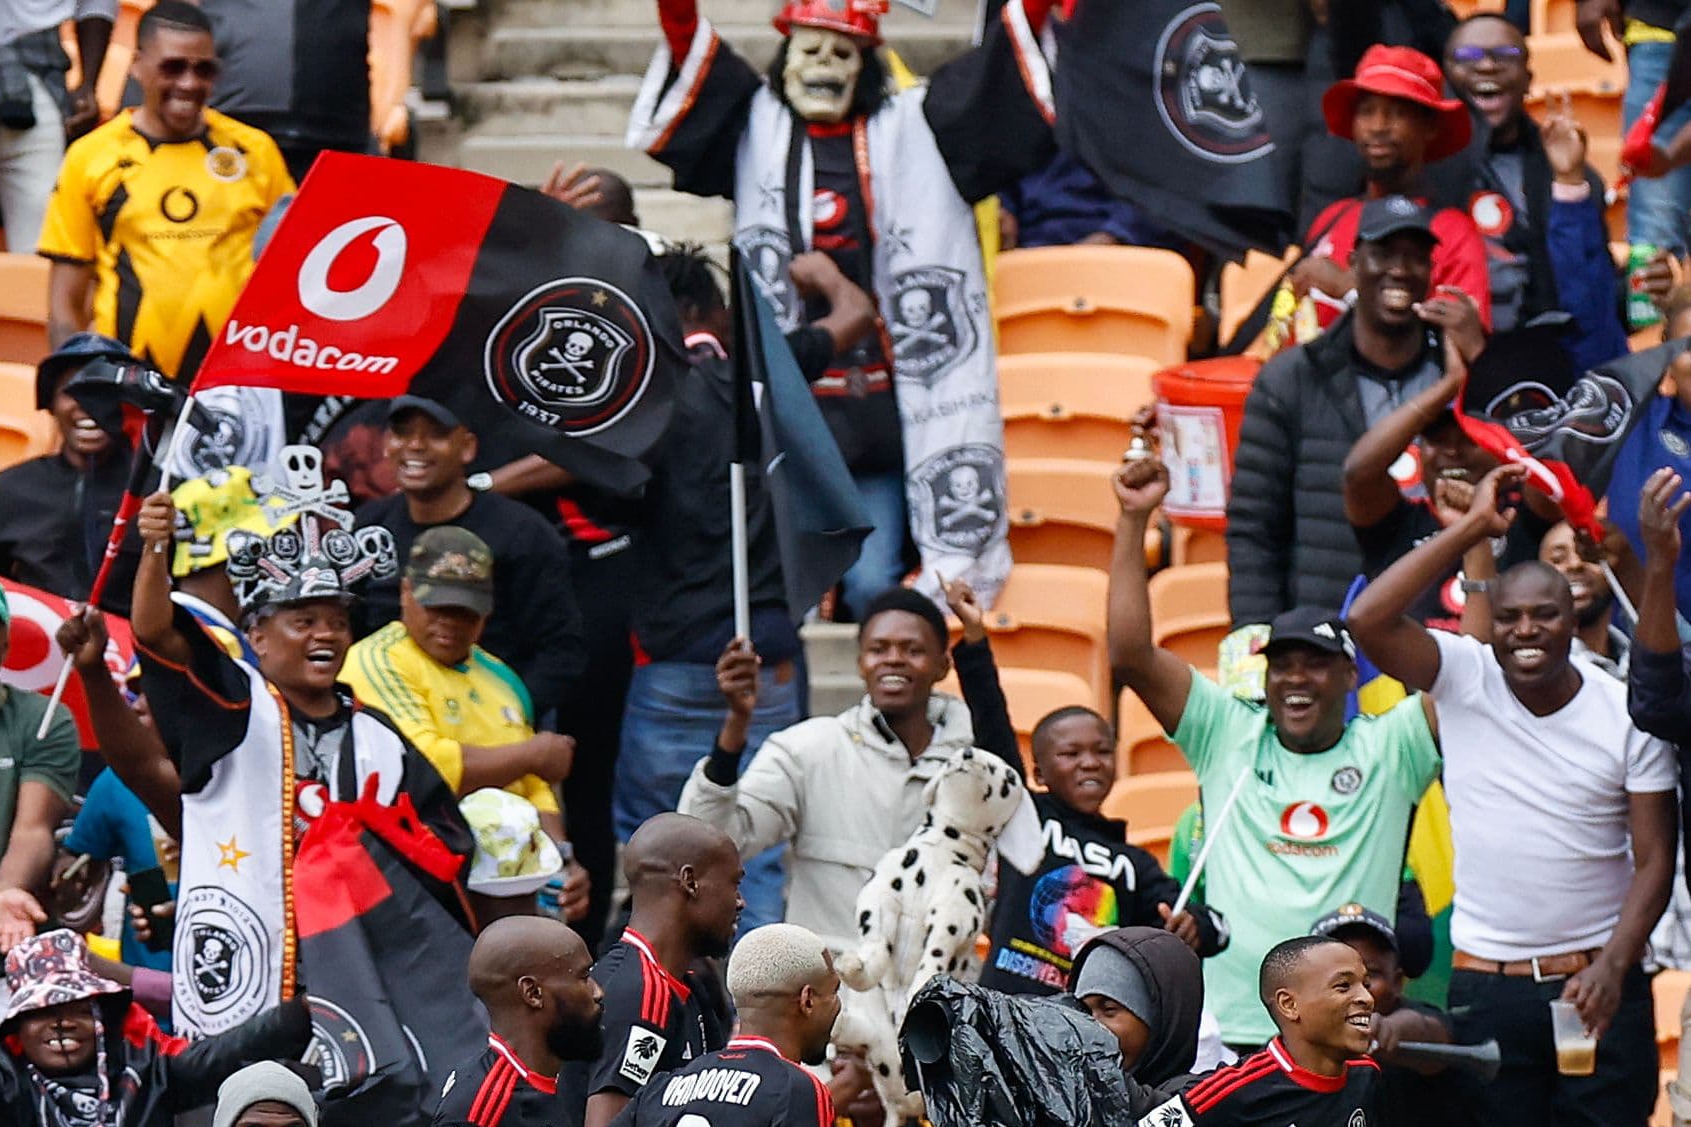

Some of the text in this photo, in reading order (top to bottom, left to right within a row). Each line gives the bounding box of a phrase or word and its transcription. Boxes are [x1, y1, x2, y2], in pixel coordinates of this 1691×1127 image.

[225, 319, 400, 375] vodacom
[552, 319, 616, 349] ORLANDO
[530, 369, 586, 395] PIRATES
[517, 401, 561, 426] 1937
[1041, 818, 1137, 892] NASA
